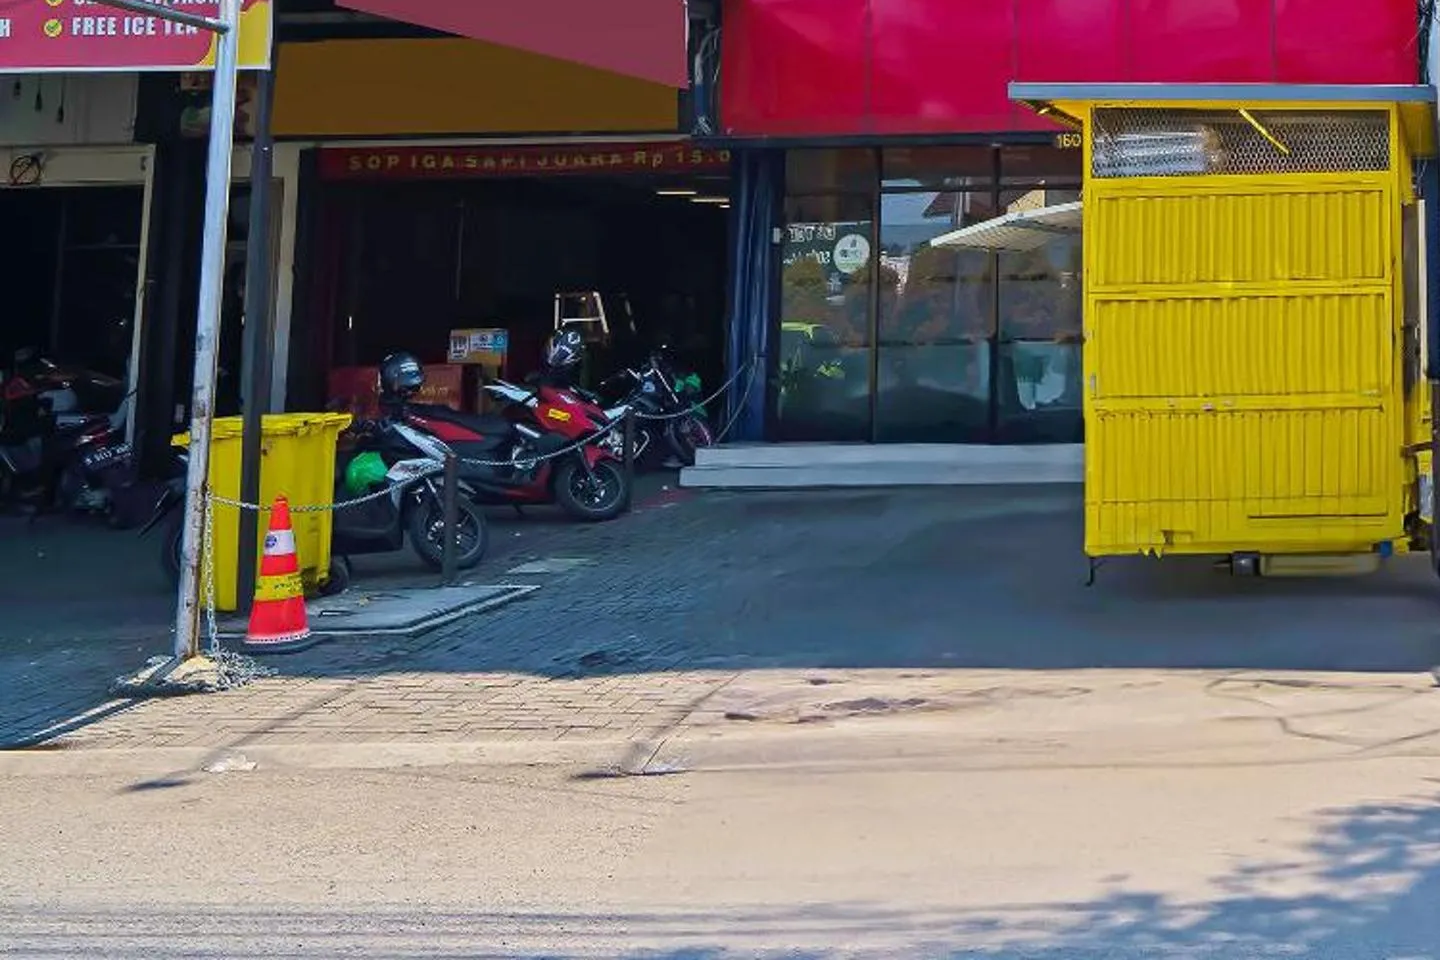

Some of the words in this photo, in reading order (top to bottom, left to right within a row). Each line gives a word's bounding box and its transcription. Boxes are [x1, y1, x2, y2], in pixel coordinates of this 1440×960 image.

[71, 16, 118, 36] FREE
[123, 16, 156, 36] ICE
[349, 154, 400, 171] SOP
[409, 154, 454, 169] IGA
